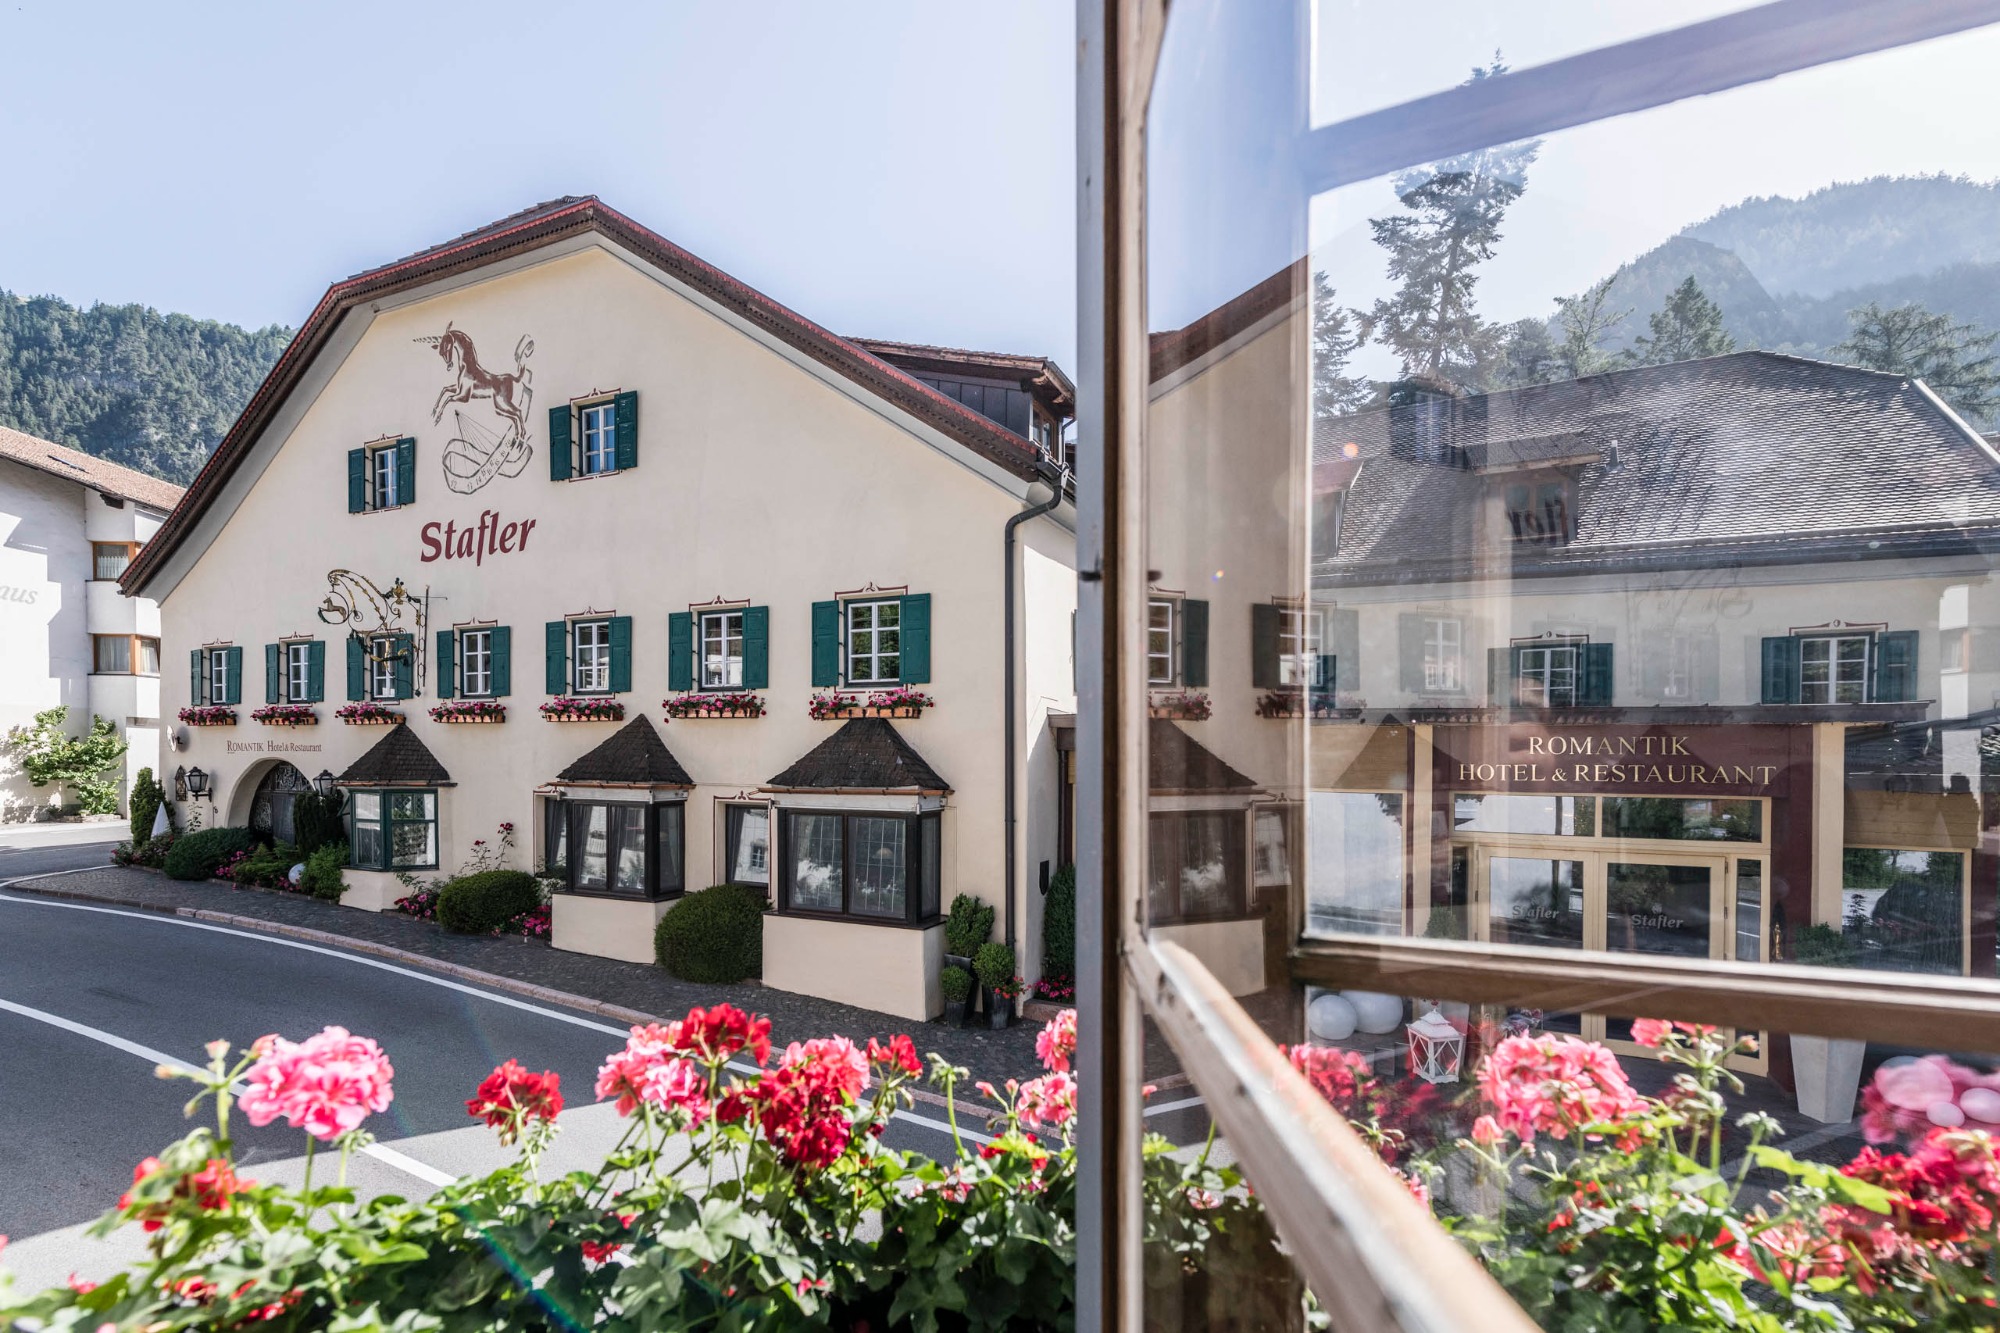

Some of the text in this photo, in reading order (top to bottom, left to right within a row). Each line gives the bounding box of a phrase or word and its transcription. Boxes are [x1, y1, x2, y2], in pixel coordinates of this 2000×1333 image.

[421, 510, 536, 567] Stafler
[290, 743, 322, 752] Restaurant
[1528, 735, 1691, 756] ROMANTIK
[1458, 763, 1777, 785] HOTEL & RESTAURANT
[1631, 914, 1684, 929] Stafler
